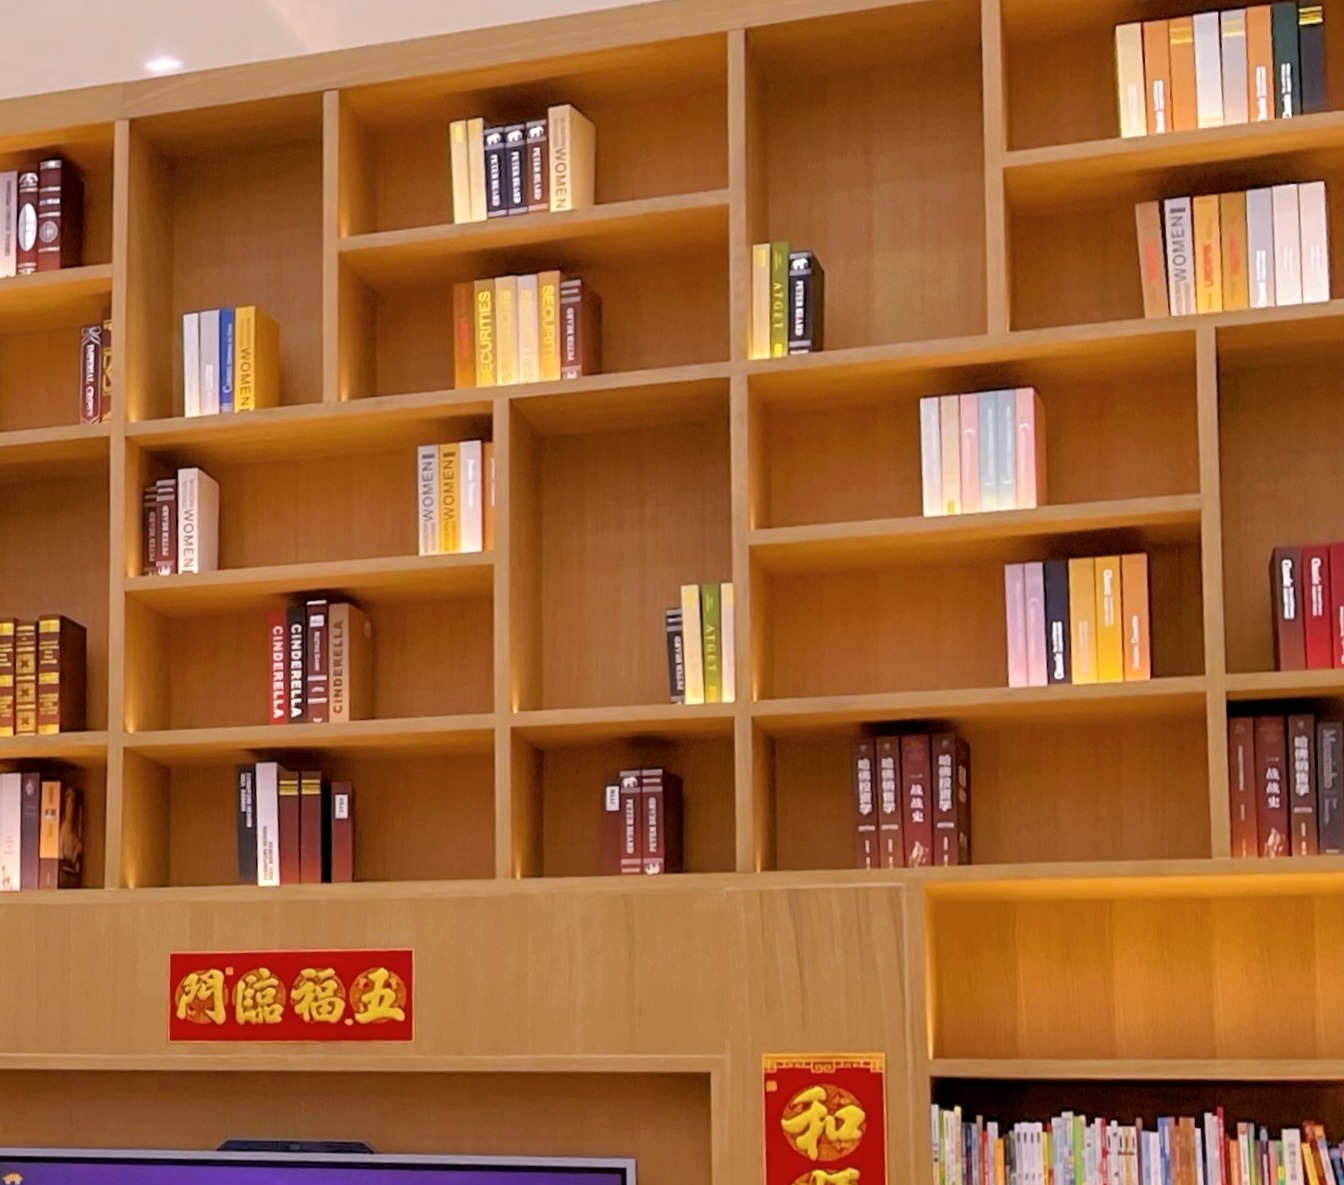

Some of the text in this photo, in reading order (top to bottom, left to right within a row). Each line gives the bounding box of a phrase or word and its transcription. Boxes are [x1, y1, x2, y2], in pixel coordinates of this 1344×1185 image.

[553, 146, 567, 211] WOMEN
[1171, 213, 1187, 283] WOMEN
[478, 290, 492, 385] SECURITIES
[773, 282, 784, 329] ATGET
[239, 346, 252, 406] WOMEN
[422, 458, 435, 523] WOMEN
[442, 456, 456, 520] WOMEN
[183, 508, 195, 568] WOMEN
[273, 624, 284, 719] CINDERELLA
[291, 623, 302, 718] CINDERELLA
[332, 620, 343, 714] CINDERELLA
[706, 625, 716, 672] ATGET
